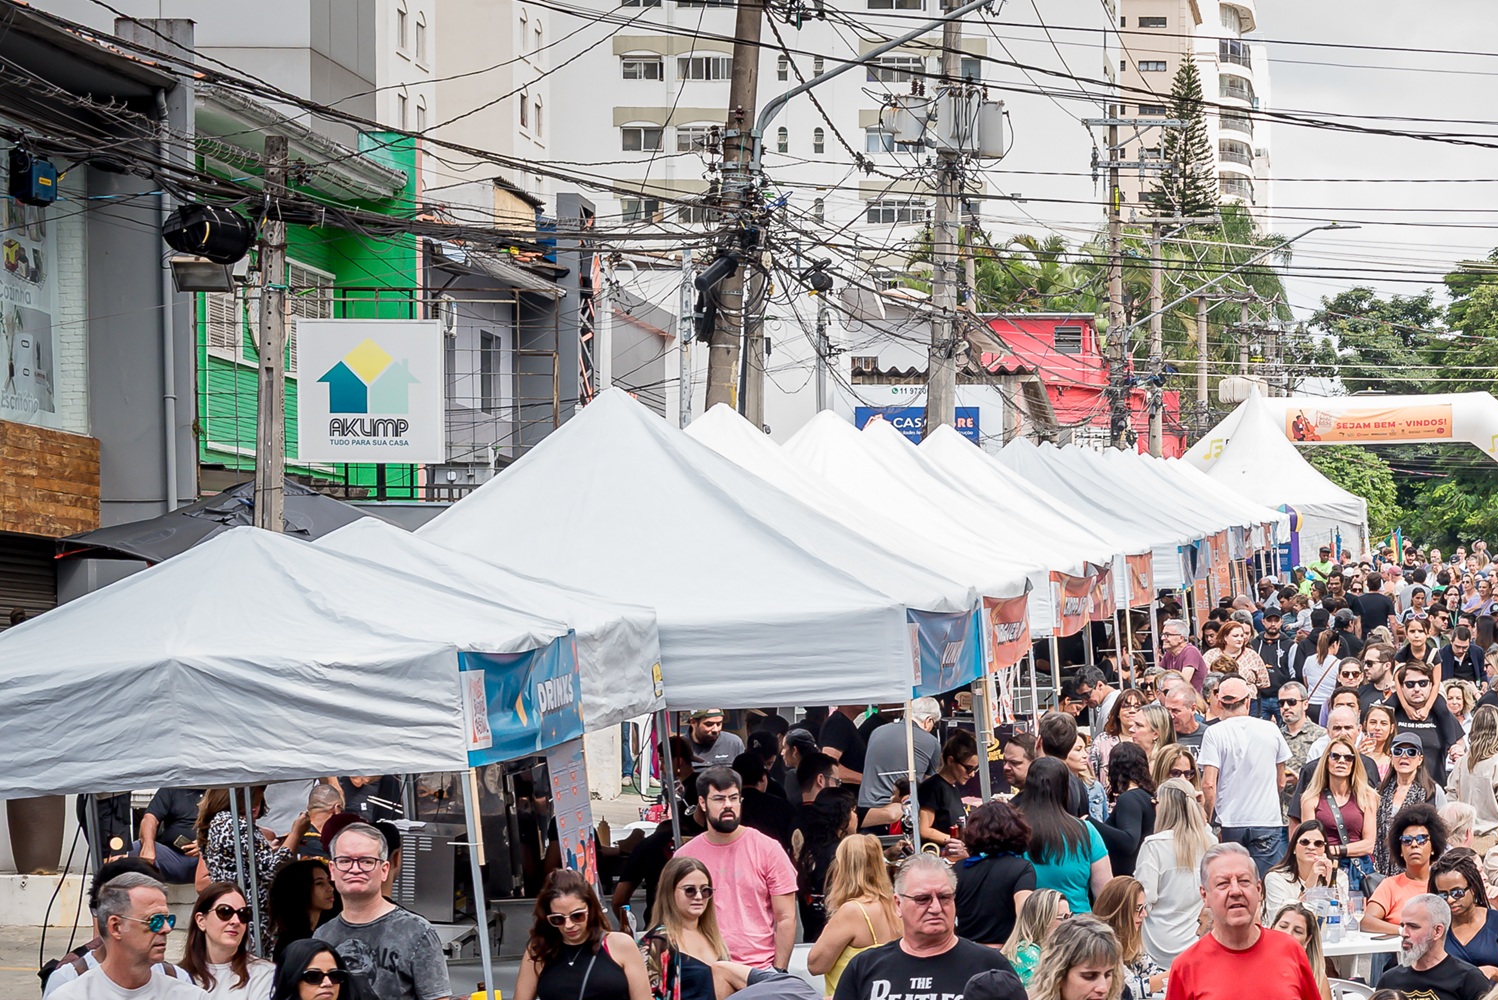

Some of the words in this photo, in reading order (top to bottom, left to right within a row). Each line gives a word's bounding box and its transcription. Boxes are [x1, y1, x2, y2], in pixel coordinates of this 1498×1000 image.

[1336, 422, 1371, 430] SEJAM
[1373, 421, 1396, 429] BEM
[1405, 418, 1448, 428] VINDOS!
[388, 439, 409, 447] CASA
[536, 672, 574, 714] DRINKS
[909, 977, 933, 989] THE
